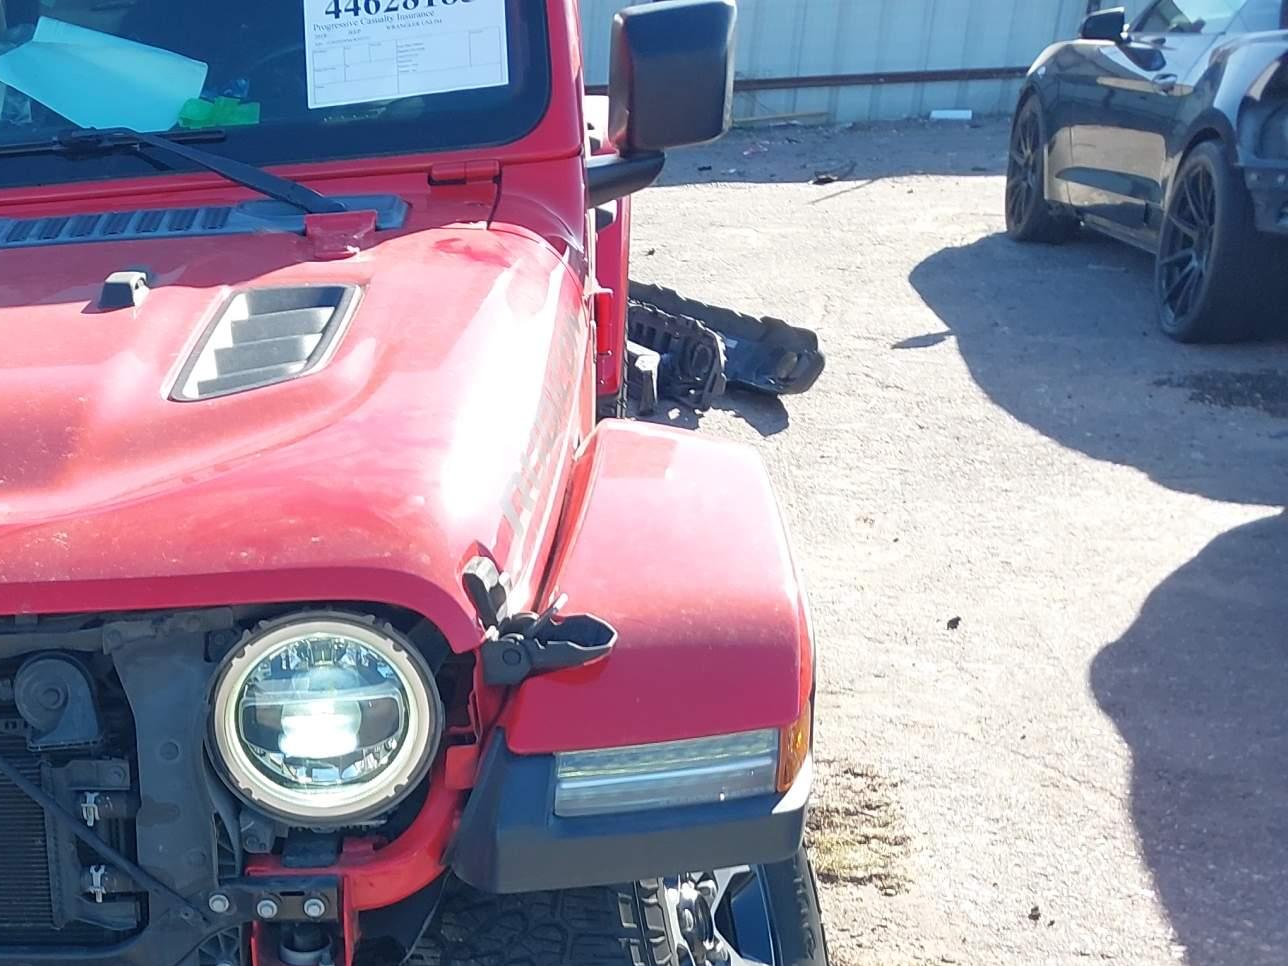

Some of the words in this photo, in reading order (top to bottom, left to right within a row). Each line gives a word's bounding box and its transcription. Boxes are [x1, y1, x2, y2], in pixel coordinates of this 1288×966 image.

[325, 0, 475, 19] 4462
[313, 20, 359, 32] Progressive
[360, 15, 393, 25] Casualty
[397, 11, 435, 21] Insurance
